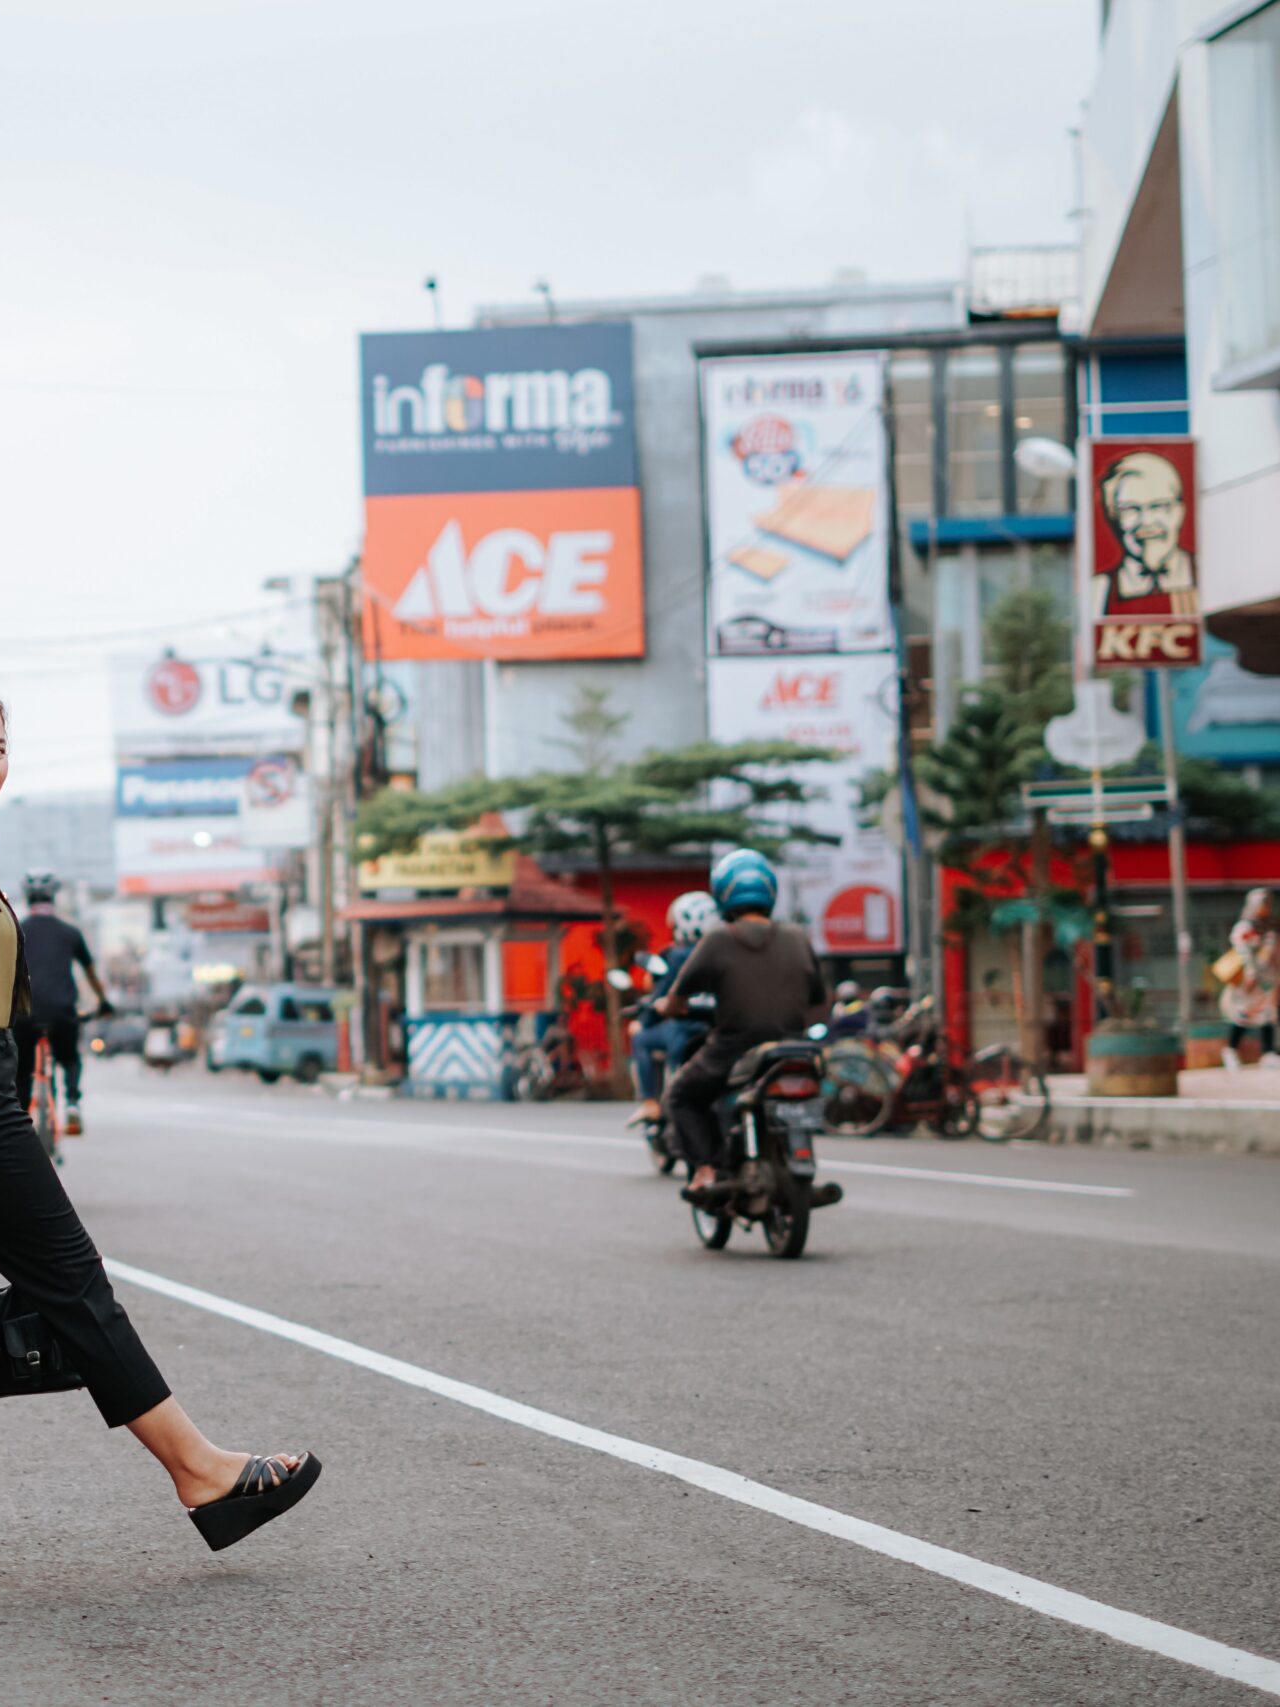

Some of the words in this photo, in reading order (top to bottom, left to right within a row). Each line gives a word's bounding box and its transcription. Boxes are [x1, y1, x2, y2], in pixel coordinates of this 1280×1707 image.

[372, 362, 613, 435] informa
[391, 517, 614, 619] ACE
[1098, 624, 1196, 661] KFC
[218, 663, 283, 705] LG
[758, 669, 842, 710] ACE
